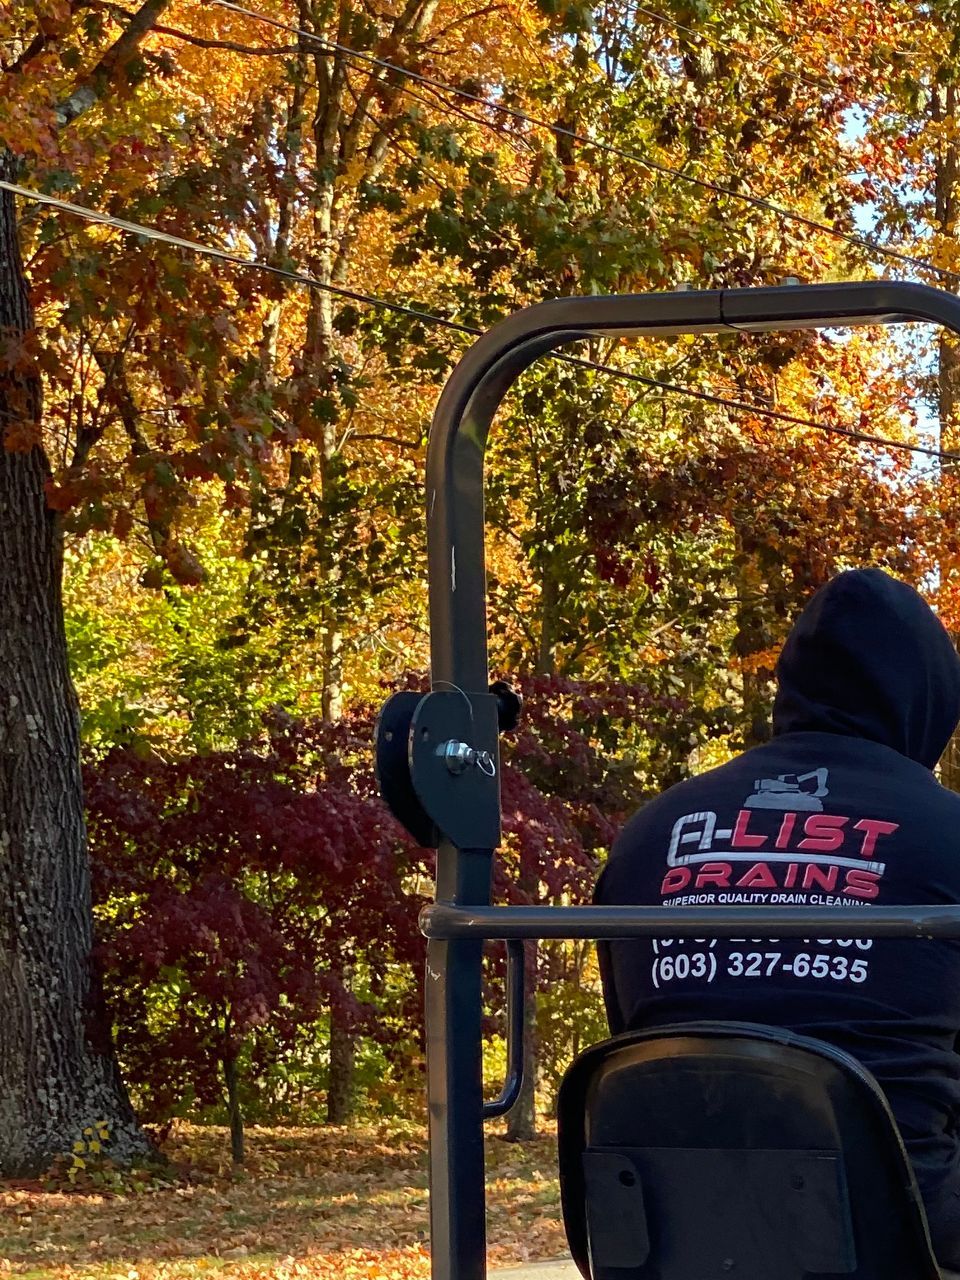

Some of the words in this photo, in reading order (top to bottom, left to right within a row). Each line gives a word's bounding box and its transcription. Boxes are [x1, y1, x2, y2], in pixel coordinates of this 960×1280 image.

[667, 810, 899, 866] A-LIST
[660, 862, 881, 899] DRAINS
[718, 894, 769, 904] QUALITY
[771, 894, 807, 904] DRAIN
[652, 952, 717, 989] (603)
[727, 952, 868, 983] 327-6535
